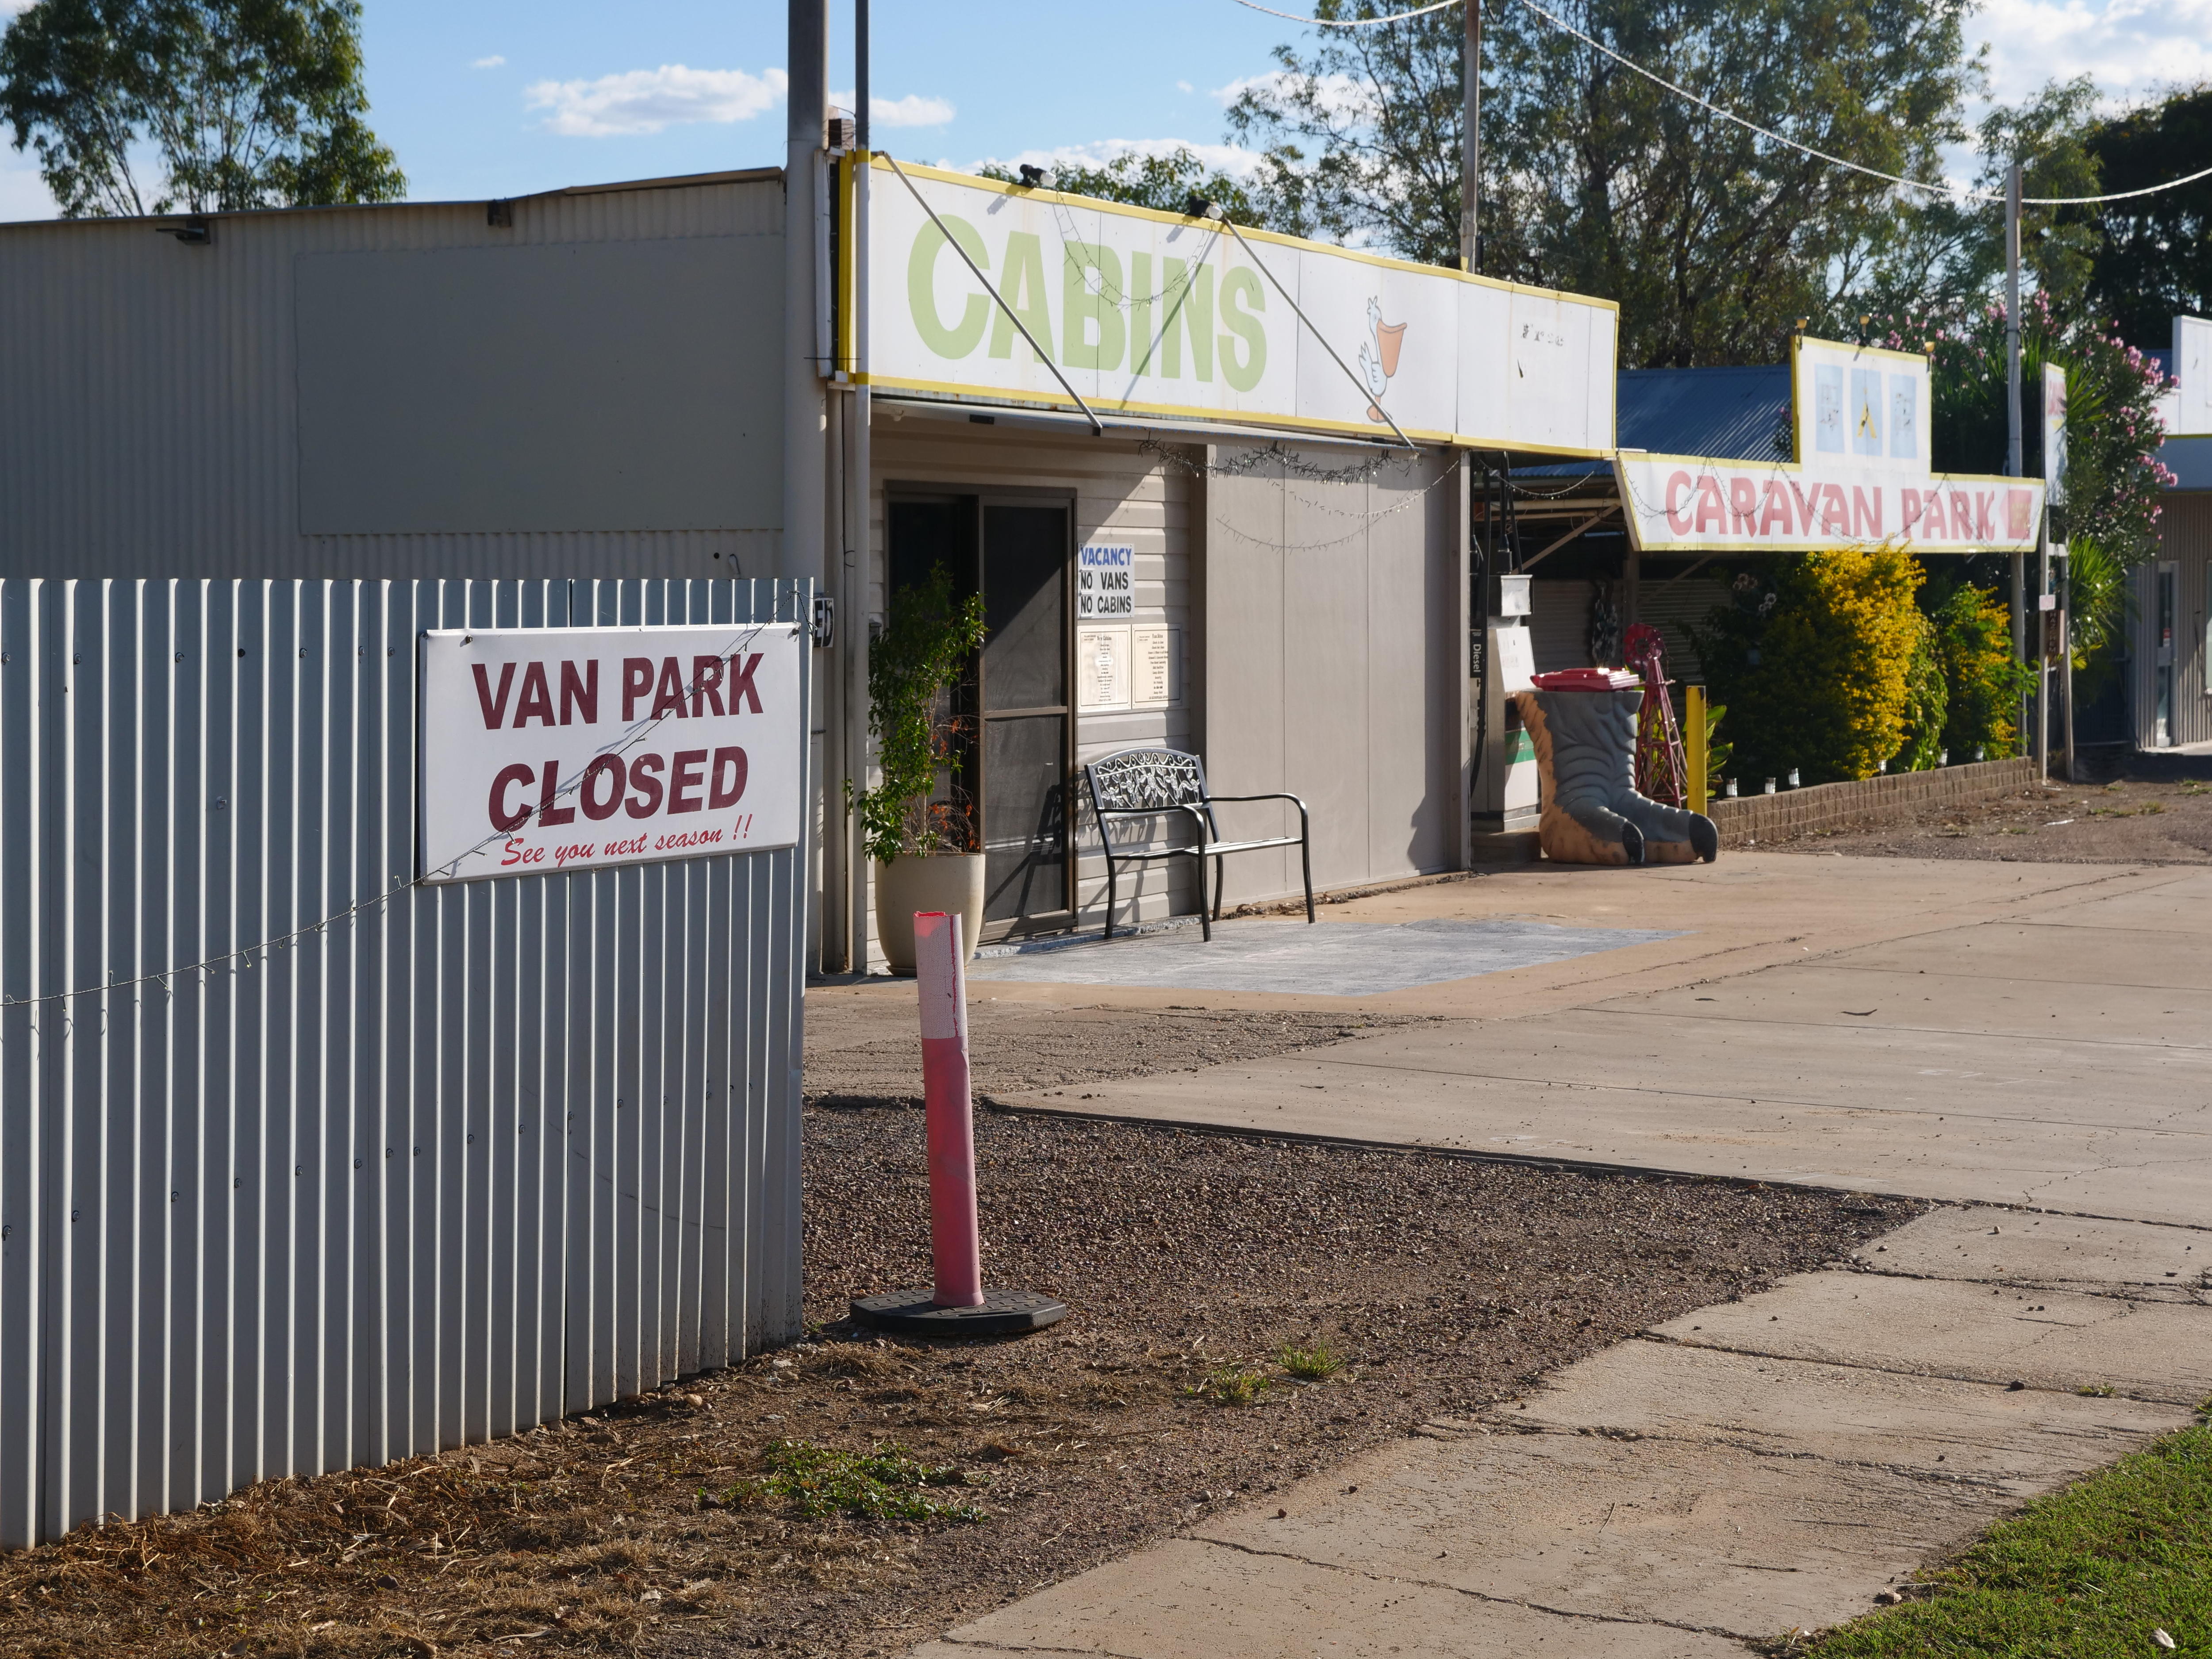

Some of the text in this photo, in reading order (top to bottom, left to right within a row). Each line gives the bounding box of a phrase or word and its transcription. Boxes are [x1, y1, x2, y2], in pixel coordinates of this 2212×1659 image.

[907, 214, 1267, 392] CABINS
[1666, 470, 1883, 538] CARAVAN
[1901, 488, 1995, 541] PARK
[1080, 547, 1132, 566] VACANCY
[1081, 571, 1129, 590] NO VANS
[1081, 595, 1132, 614] NO CABINS
[1473, 644, 1482, 672] Diesel
[471, 653, 765, 730] VAN PARK
[488, 746, 749, 833] CLOSED
[501, 814, 753, 868] See you next season !!
